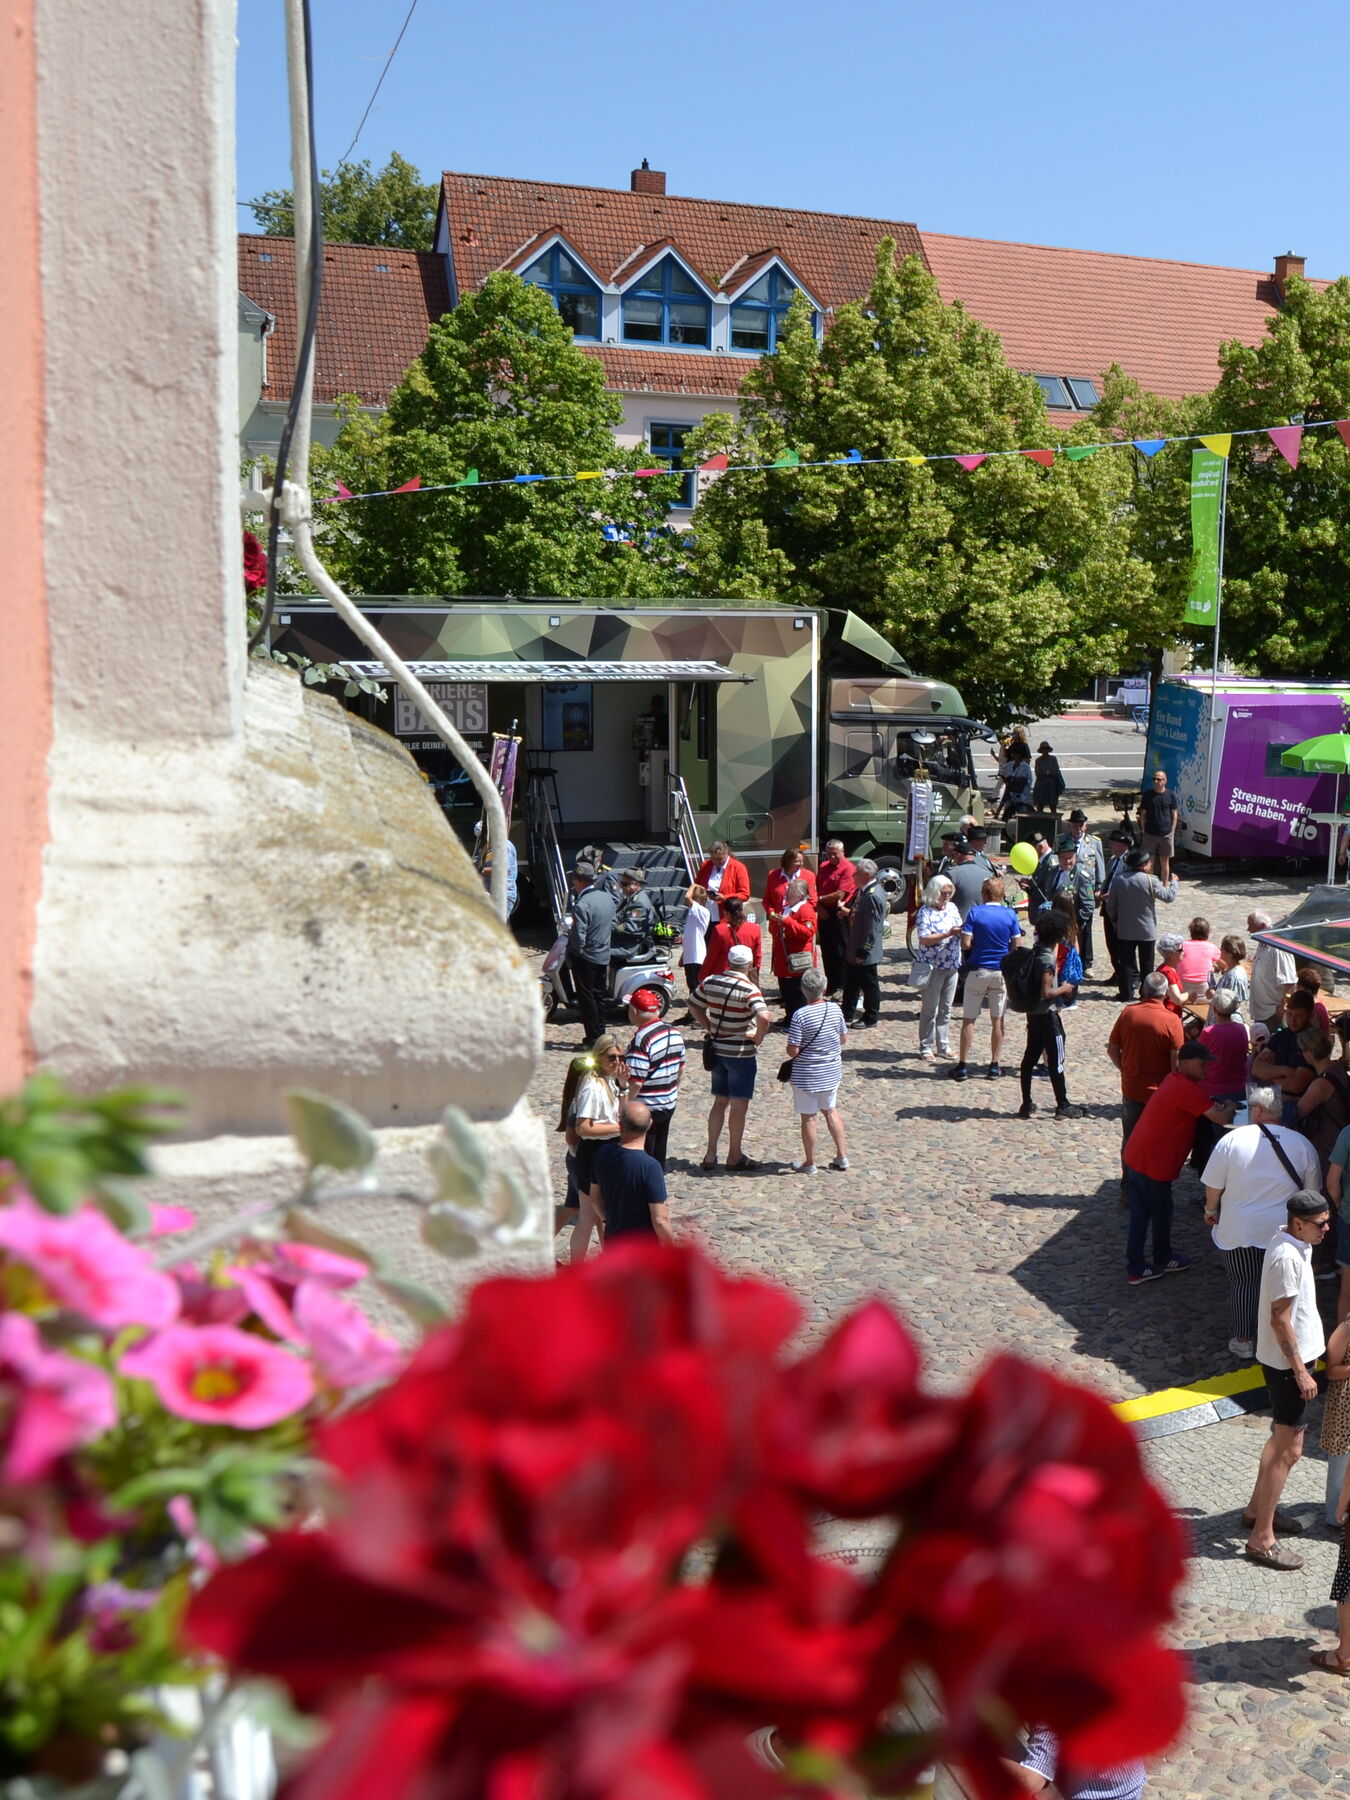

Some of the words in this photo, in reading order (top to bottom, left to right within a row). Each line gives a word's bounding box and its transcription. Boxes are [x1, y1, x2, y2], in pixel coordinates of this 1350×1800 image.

[1156, 711, 1166, 722] Ein
[1167, 713, 1182, 727] Band
[1170, 728, 1187, 742] Leben
[1231, 787, 1280, 809] Streamen.
[1228, 799, 1254, 814] Spaß
[1255, 805, 1287, 822] haben.
[1289, 817, 1318, 840] tio
